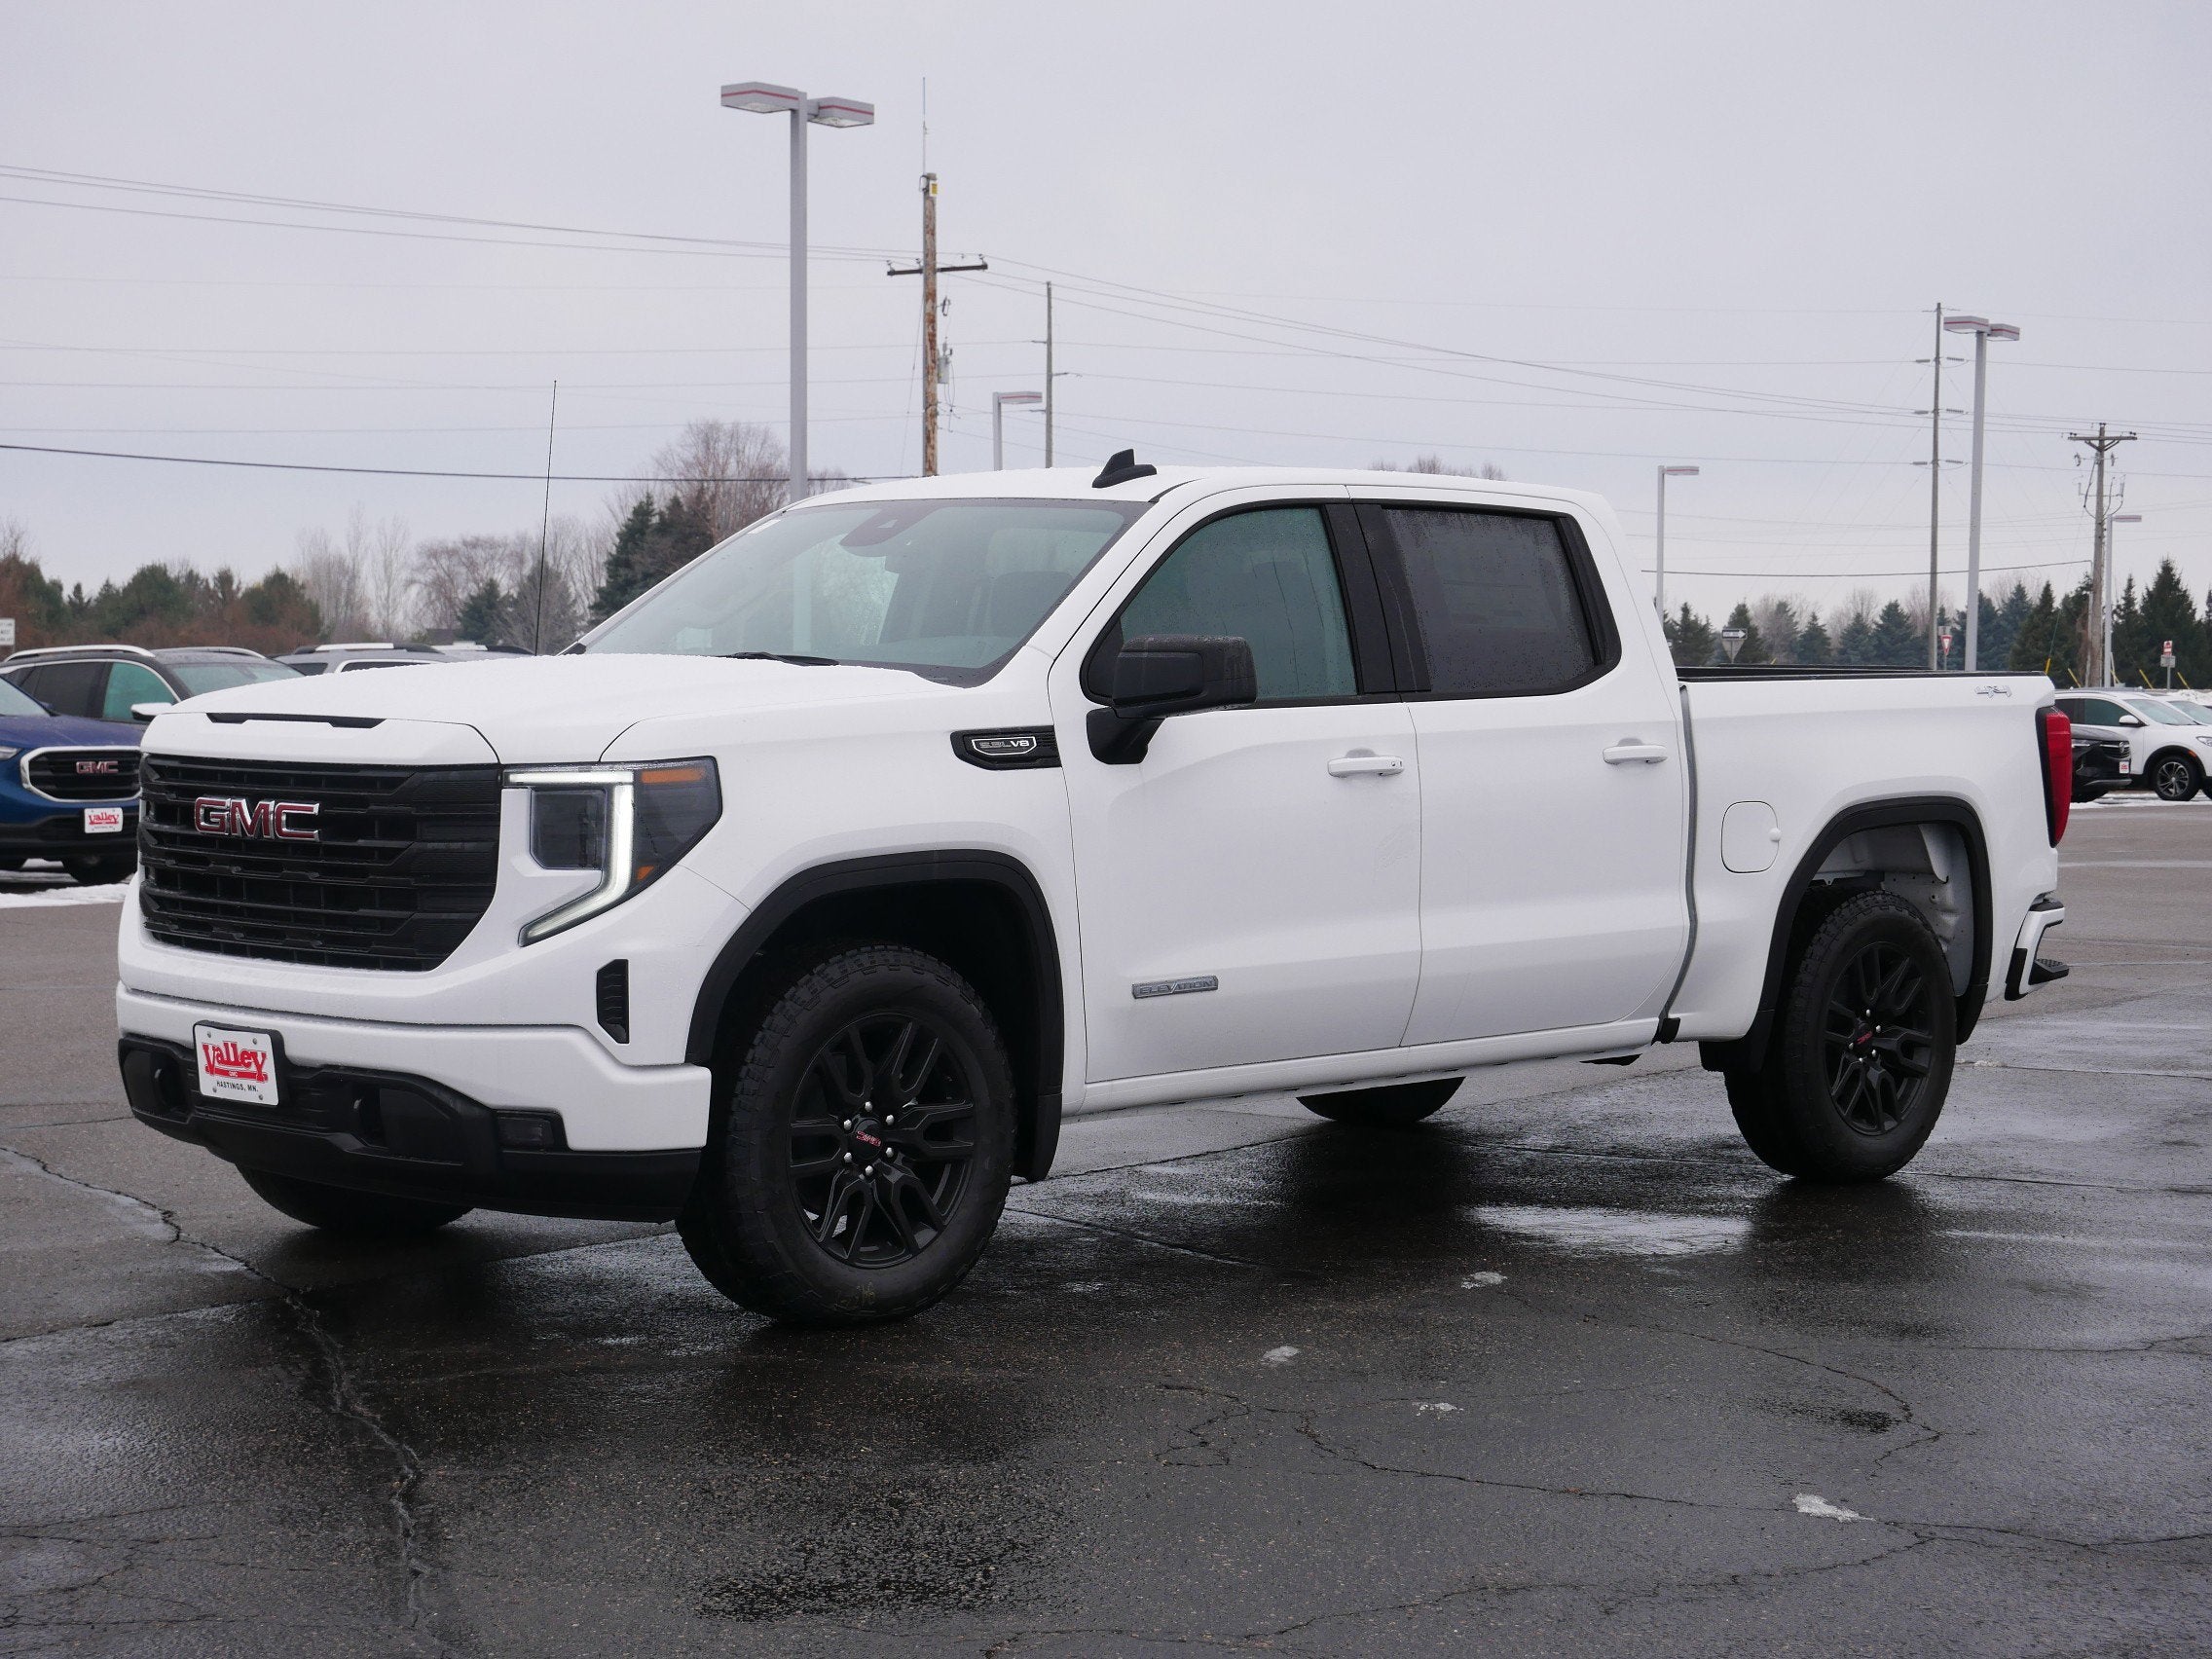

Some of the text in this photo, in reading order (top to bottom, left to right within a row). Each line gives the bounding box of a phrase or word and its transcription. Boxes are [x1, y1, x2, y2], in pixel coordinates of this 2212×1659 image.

[76, 760, 118, 773] GMC
[89, 812, 119, 826] Valley
[194, 796, 319, 842] GMC
[1139, 979, 1213, 994] ELEVATION
[201, 1040, 268, 1083] Valley
[216, 1081, 246, 1090] HASTINGS,
